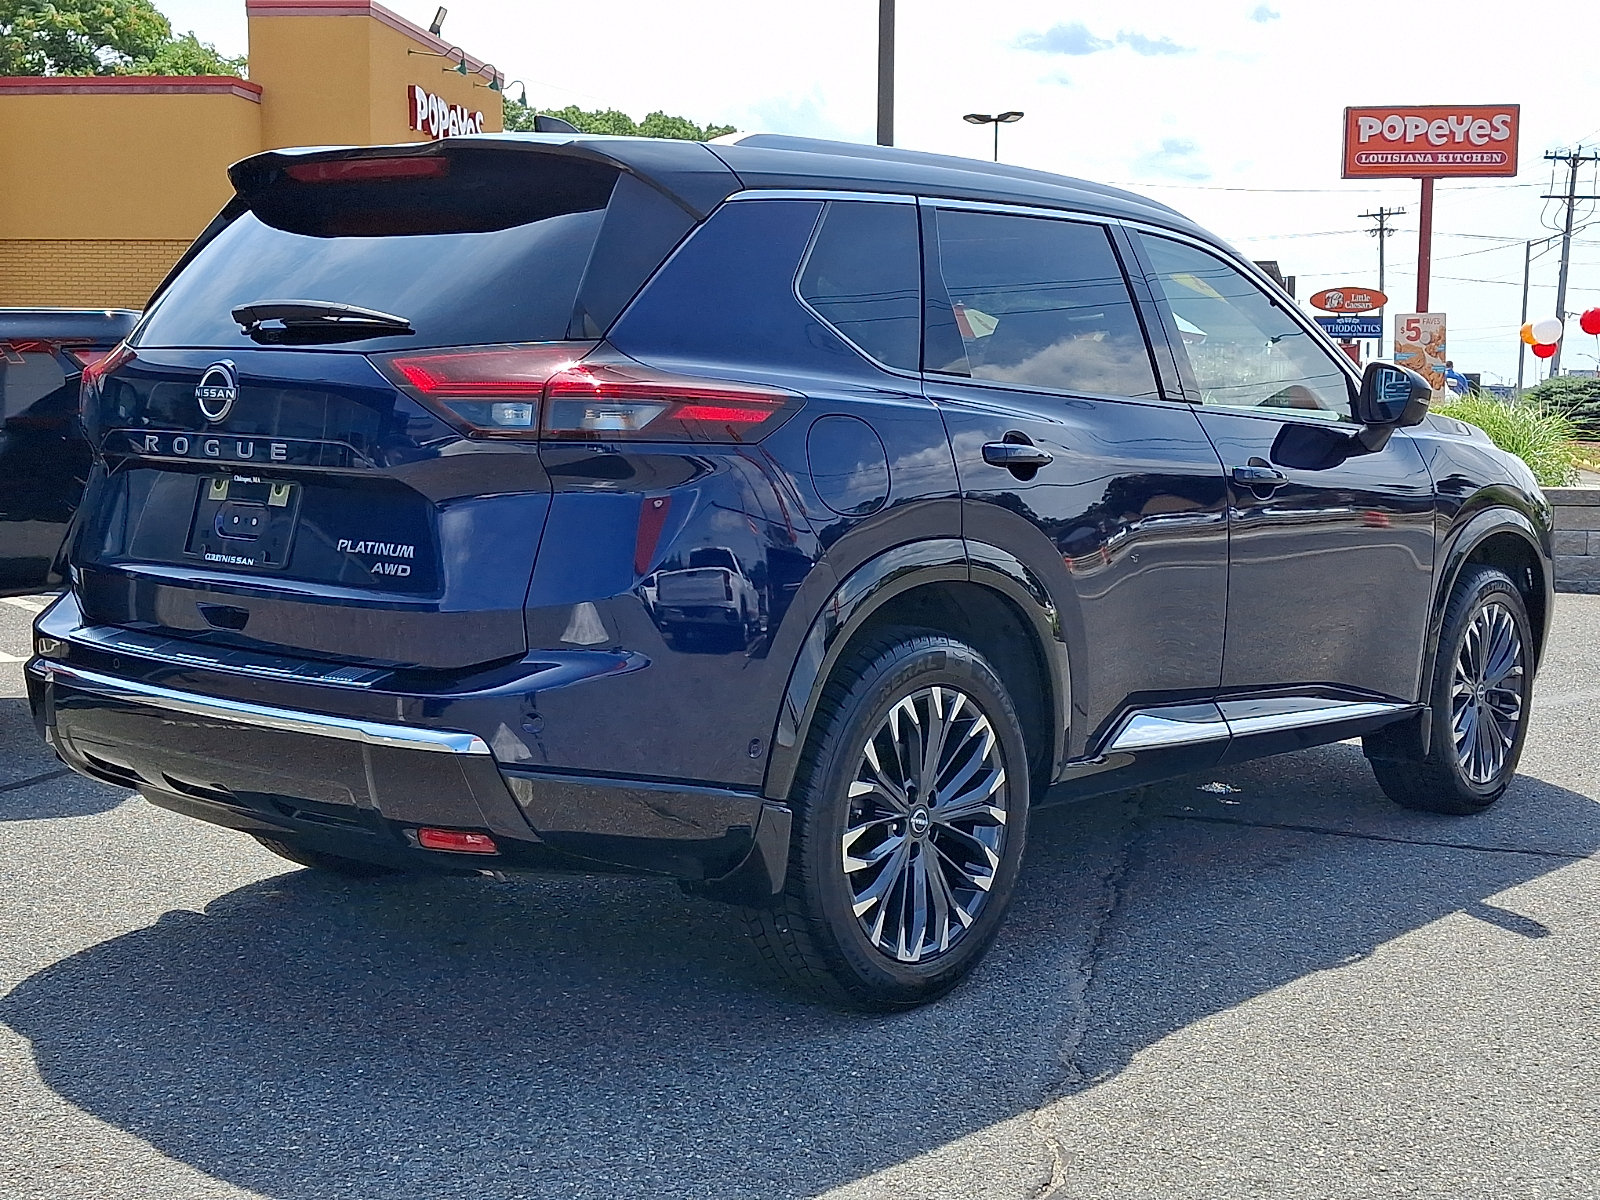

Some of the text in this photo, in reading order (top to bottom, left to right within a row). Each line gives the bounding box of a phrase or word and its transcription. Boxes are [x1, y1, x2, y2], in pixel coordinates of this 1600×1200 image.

[1361, 152, 1502, 163] LOUISIANA KITCHEN
[1351, 293, 1371, 302] Little
[1344, 301, 1373, 309] Caesars
[1422, 317, 1440, 325] FAVES
[1321, 324, 1381, 333] RTHODONTICS
[195, 387, 236, 399] NISSAN
[144, 434, 288, 461] ROGUE
[336, 538, 415, 559] PLATINUM
[370, 562, 411, 577] AWD
